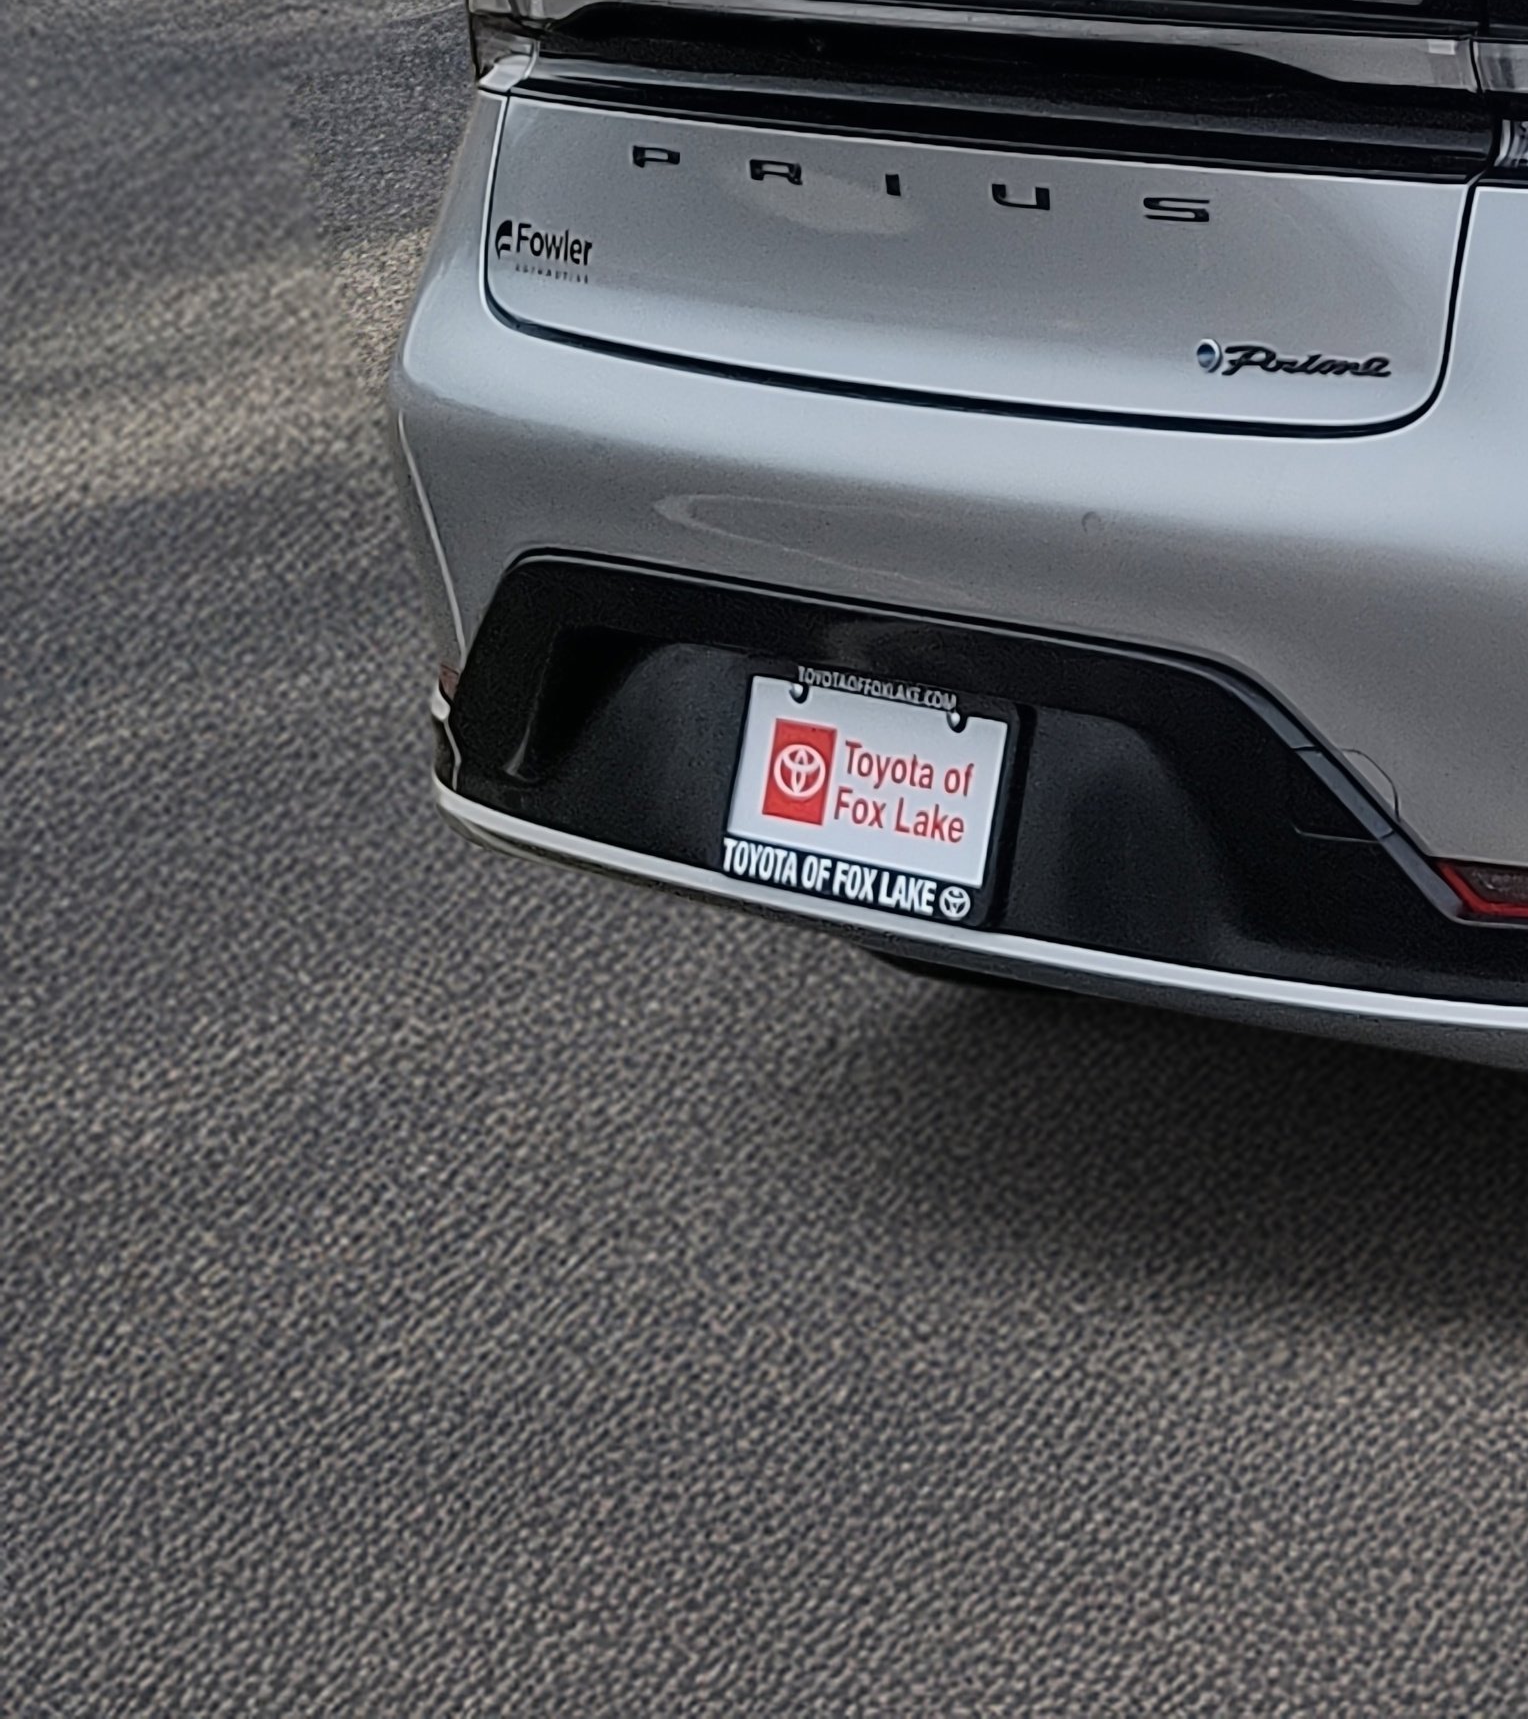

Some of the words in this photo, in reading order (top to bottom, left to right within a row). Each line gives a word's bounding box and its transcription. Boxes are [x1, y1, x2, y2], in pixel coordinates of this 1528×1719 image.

[632, 145, 1210, 222] PRIUS
[516, 222, 593, 266] Fowler
[845, 740, 934, 790] Toyota
[944, 763, 975, 797] of
[834, 786, 887, 829] Fox
[895, 797, 965, 843] Lake
[723, 837, 798, 886] TOYOTA
[801, 855, 832, 892] OF
[832, 861, 879, 904] FOX
[878, 871, 937, 916] LAKE
